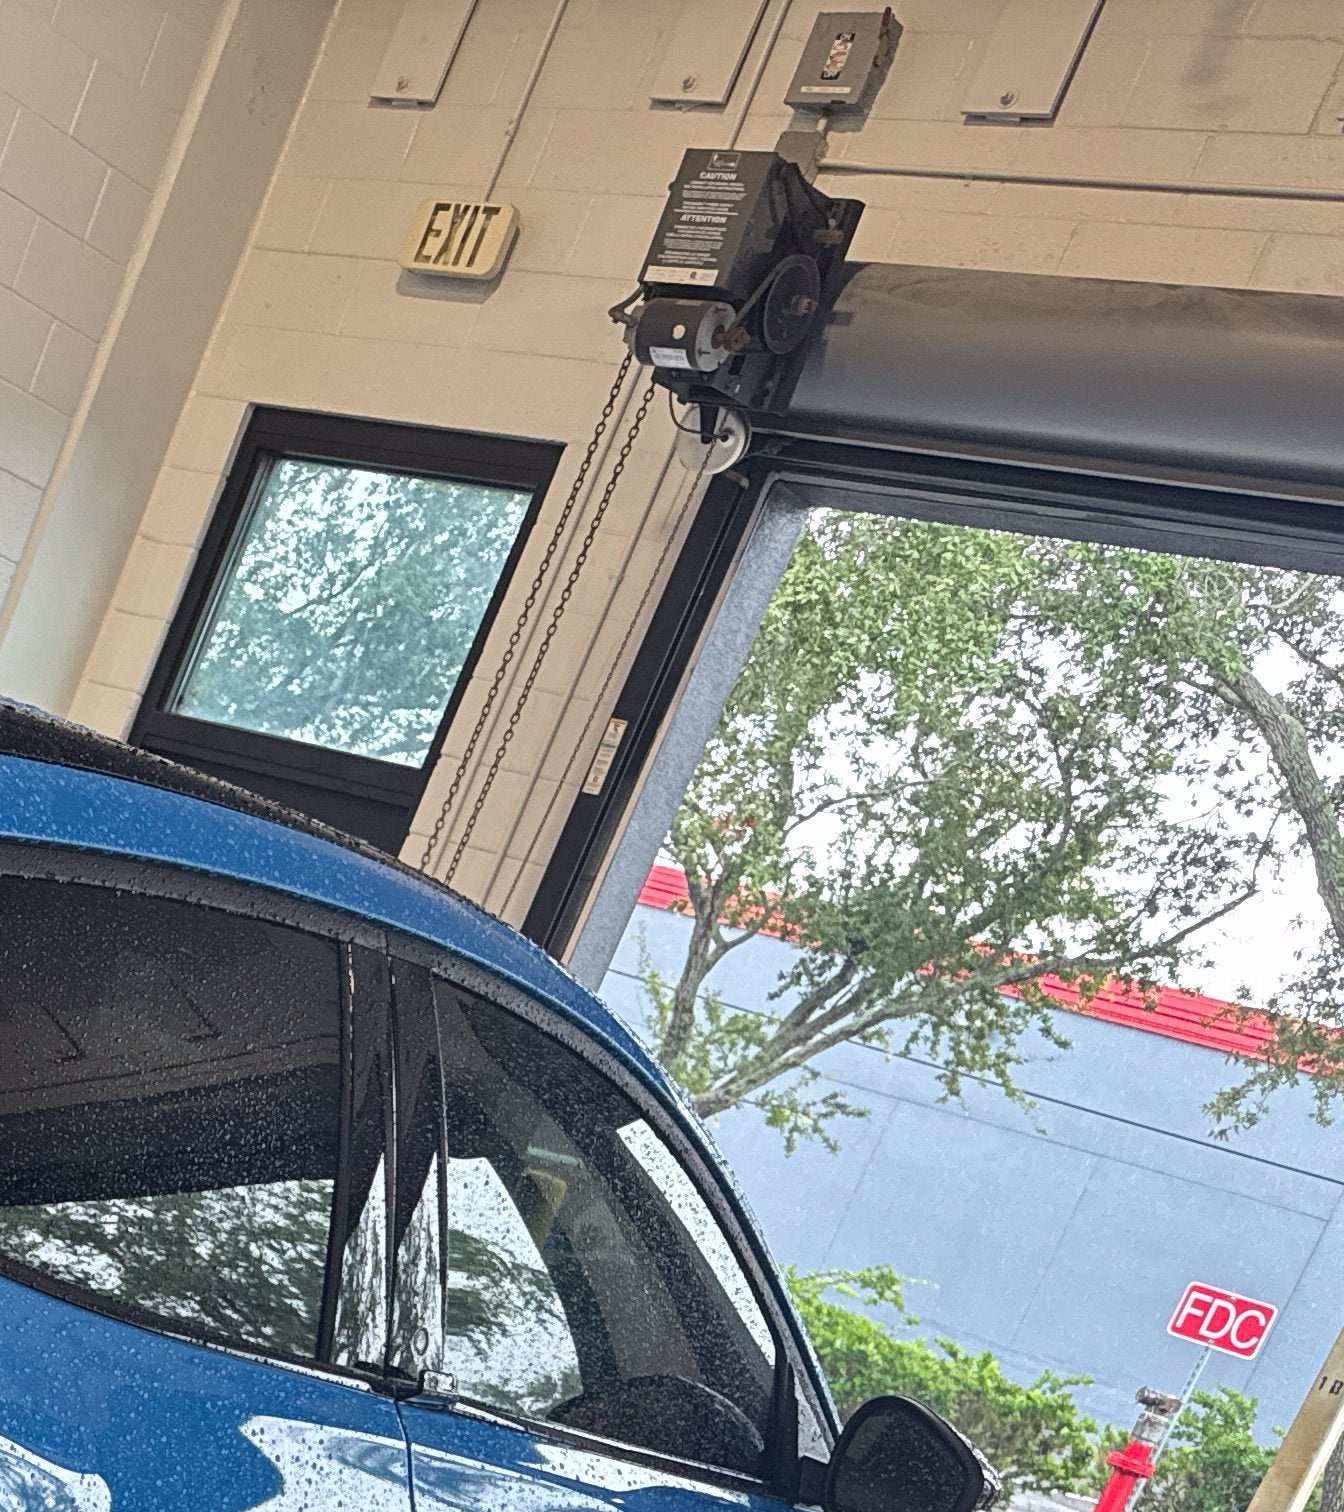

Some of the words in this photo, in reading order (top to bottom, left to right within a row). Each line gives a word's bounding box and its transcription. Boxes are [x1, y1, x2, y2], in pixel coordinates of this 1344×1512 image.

[699, 171, 737, 181] CAUTION
[414, 203, 502, 268] EXIT
[680, 214, 728, 224] ATTENTION
[1175, 1291, 1266, 1349] FDC
